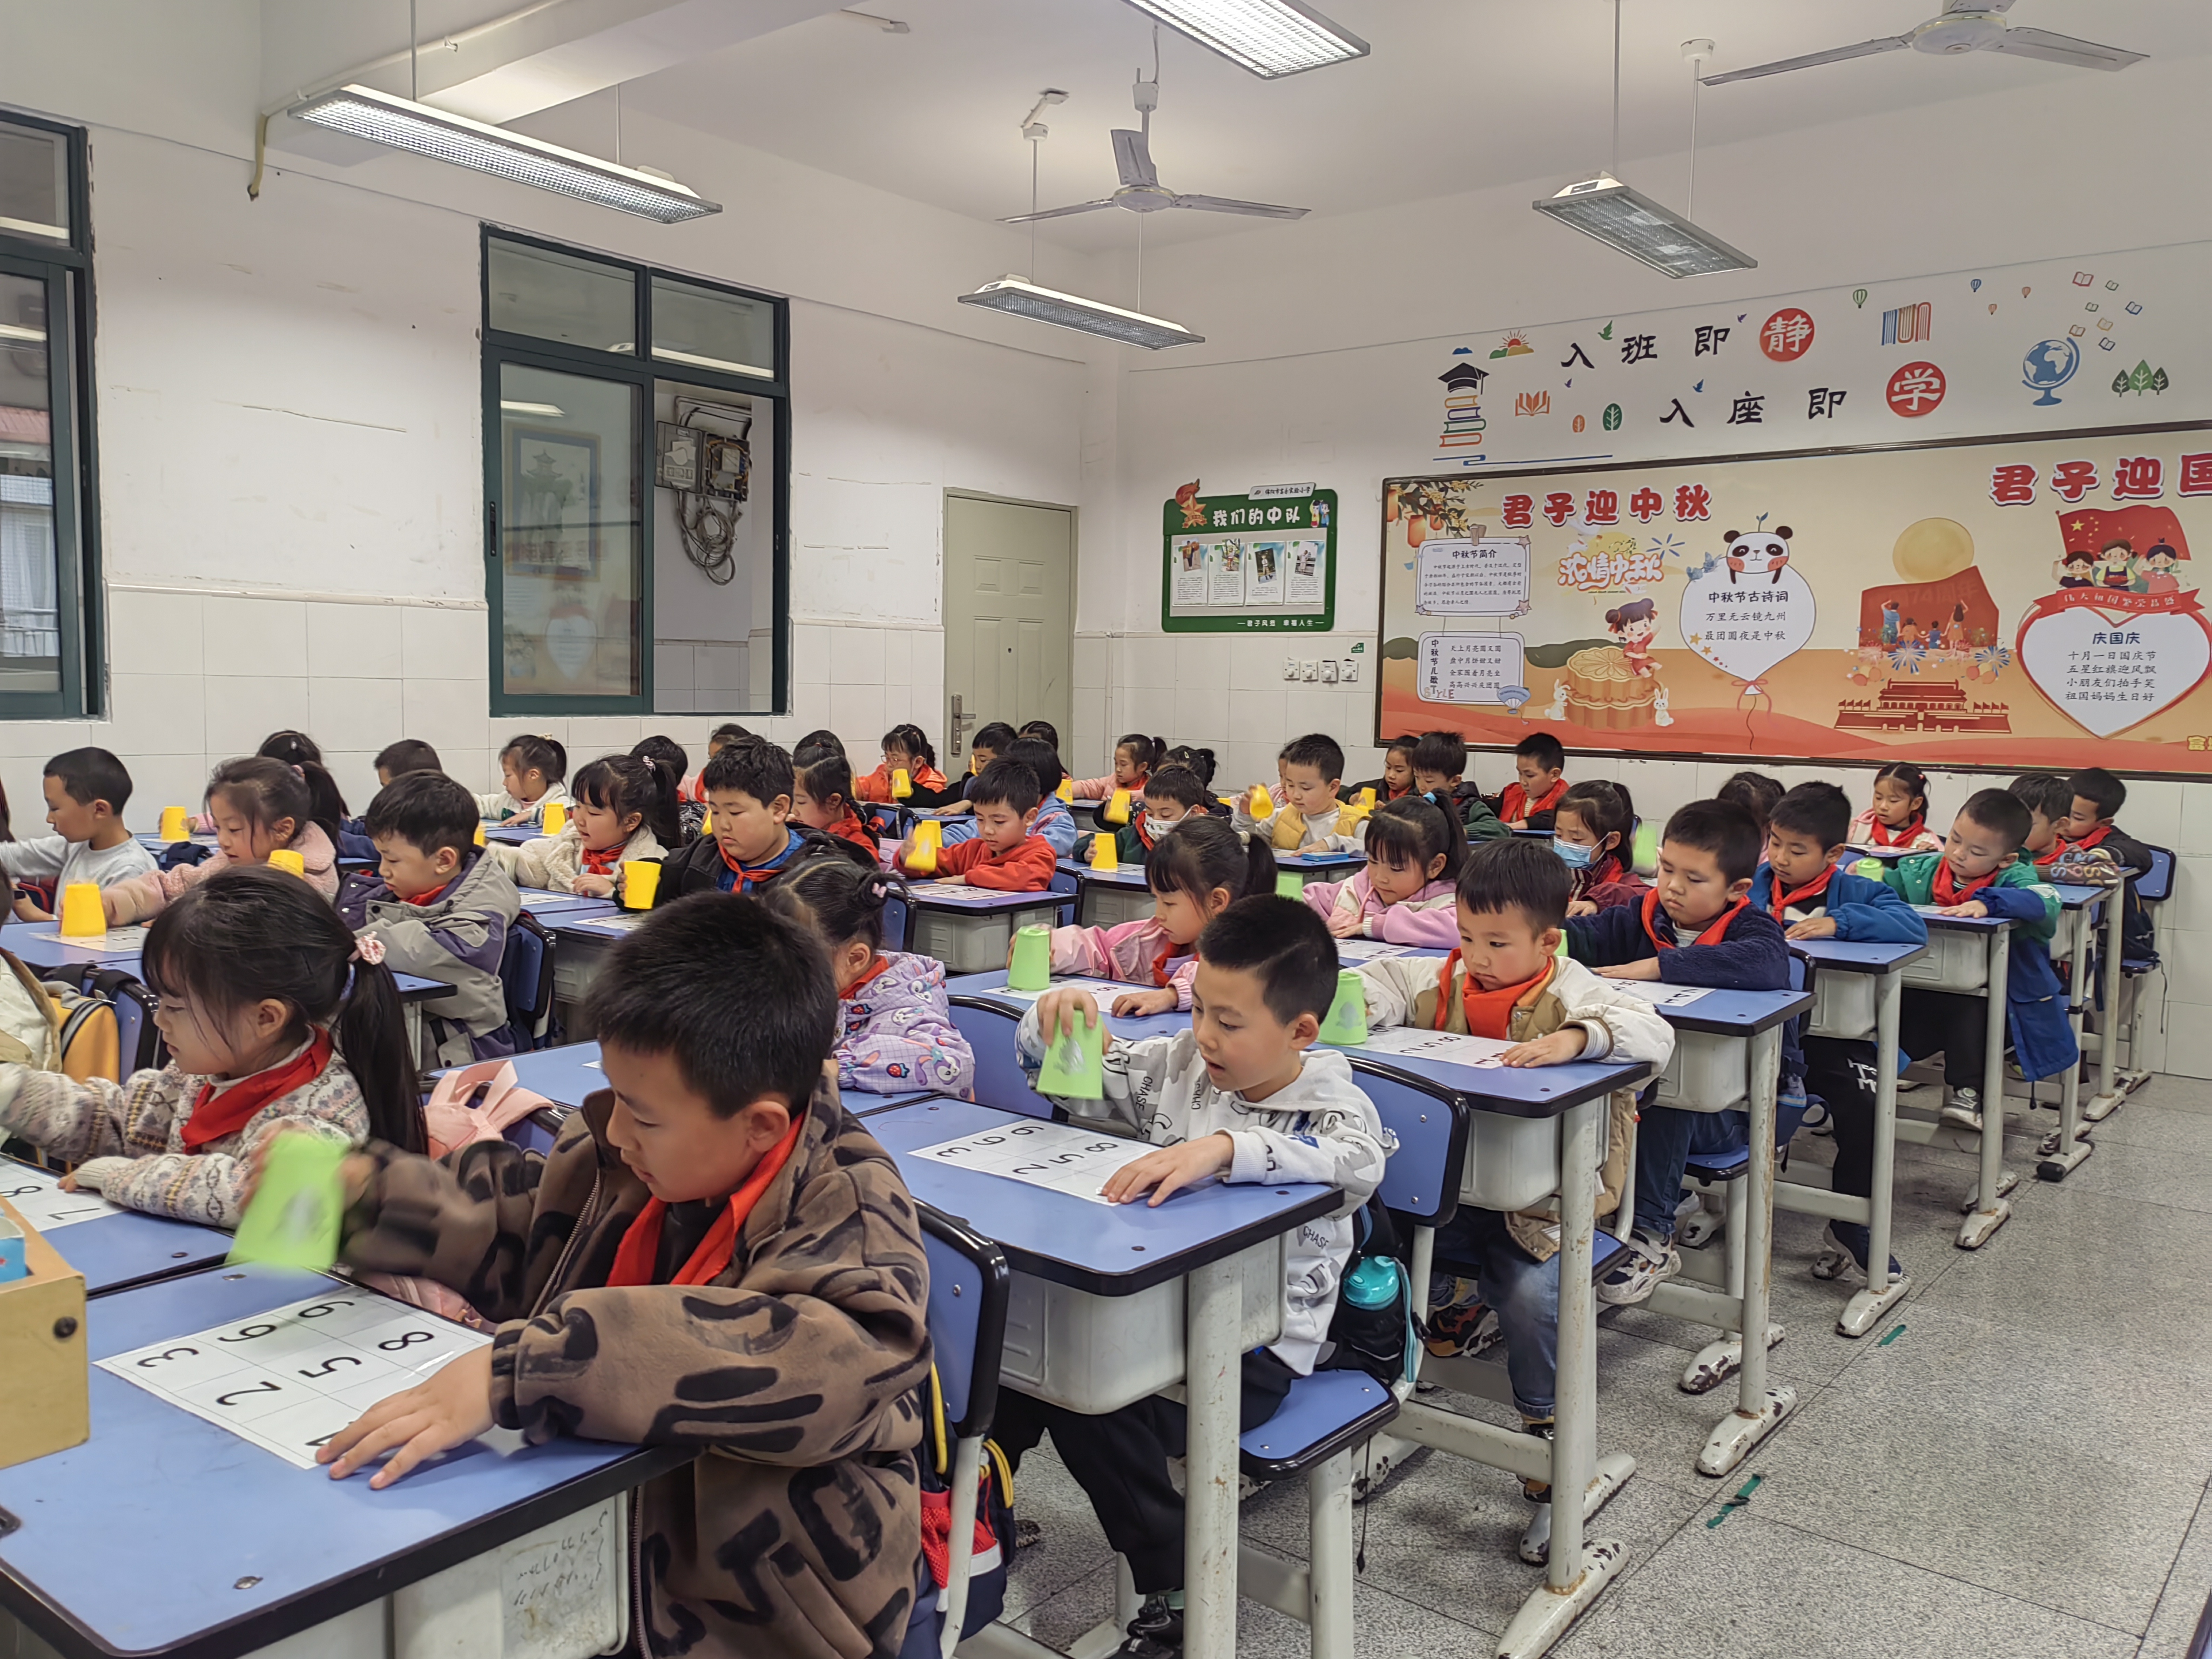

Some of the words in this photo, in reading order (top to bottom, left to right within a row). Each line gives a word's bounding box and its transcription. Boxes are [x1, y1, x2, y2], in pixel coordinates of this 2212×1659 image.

[1561, 313, 1812, 368] 入班即静
[1660, 368, 1942, 428] 入座即学
[1502, 484, 1712, 528] 君子迎中秋
[1212, 506, 1300, 527] 我们的中队
[1452, 549, 1498, 559] 中秋节简介
[1557, 551, 1664, 591] 浓情中秋
[1709, 590, 1789, 603] 中秋节古诗词
[2064, 592, 2175, 608] 伟大祖国繁荣昌盛
[1705, 611, 1786, 622] 万里无云镜九州
[1705, 630, 1786, 641] 最团圆夜是中秋
[2092, 632, 2140, 645] 庆国庆
[1450, 644, 1502, 653] 天上月亮圆又圆
[1430, 639, 1440, 685] 中秋节儿歌
[1449, 657, 1501, 665] 盘中月饼甜又甜
[2068, 651, 2157, 661] 十月一日国庆节
[2067, 665, 2157, 675] 五星红旗迎风飘
[2066, 678, 2155, 689] 小朋友们拍手笑
[2065, 692, 2155, 702] 祖国妈妈生日好
[1135, 1076, 1153, 1111] CHASE
[1010, 1126, 1045, 1135] 9
[972, 1136, 1007, 1145] 6
[1084, 1142, 1118, 1152] 8
[936, 1147, 972, 1157] 3
[1048, 1154, 1085, 1164] 5
[1012, 1163, 1050, 1175] 2
[299, 1301, 355, 1319] 9
[218, 1324, 278, 1344] 6
[379, 1331, 435, 1351] 8
[137, 1347, 199, 1368] 3
[298, 1356, 362, 1379] 5
[216, 1381, 282, 1406] 2
